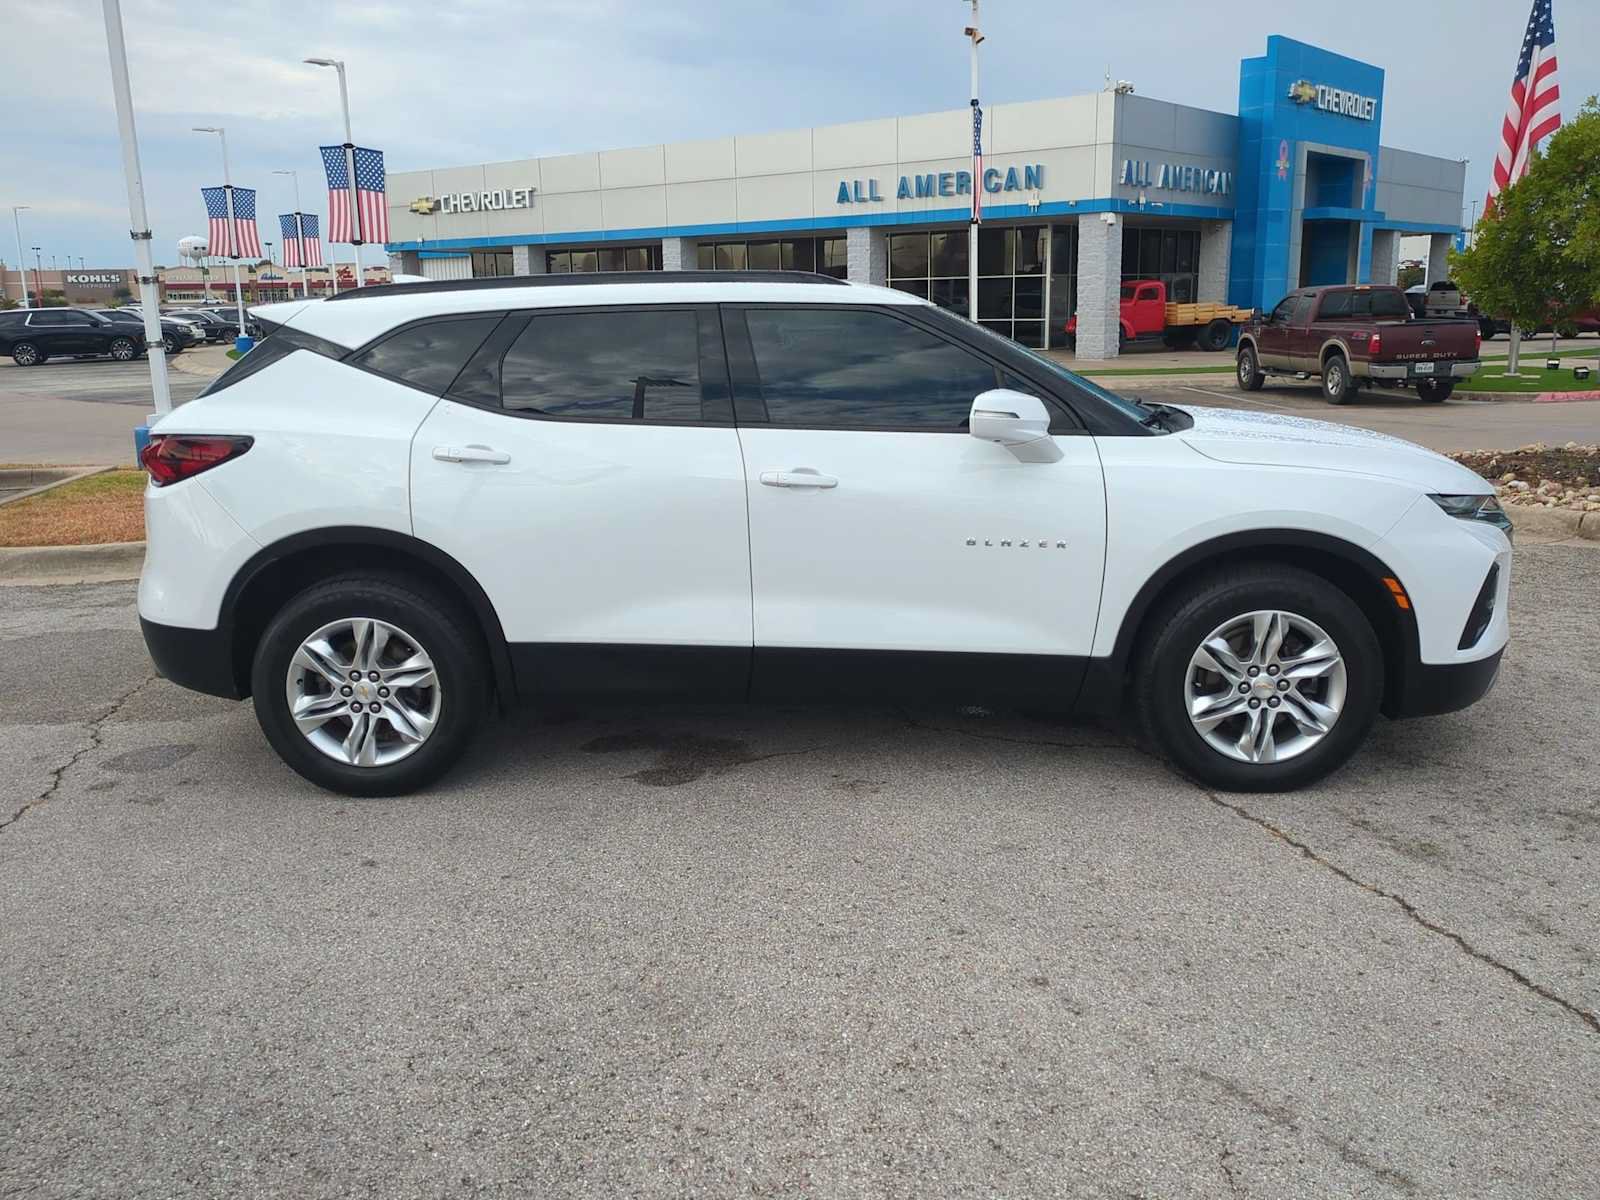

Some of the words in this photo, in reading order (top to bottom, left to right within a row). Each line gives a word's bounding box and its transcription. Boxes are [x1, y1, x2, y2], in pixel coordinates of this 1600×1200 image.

[1317, 85, 1377, 121] CHEVROLET
[837, 178, 884, 204] ALL
[896, 164, 1044, 200] AMERCAN
[1120, 159, 1152, 187] ALL
[1156, 164, 1232, 195] AMERICAN
[440, 187, 535, 214] CHEVROLET
[67, 274, 120, 283] KOHL'S
[1433, 351, 1458, 359] DUTY
[965, 537, 1067, 549] BLAZER
